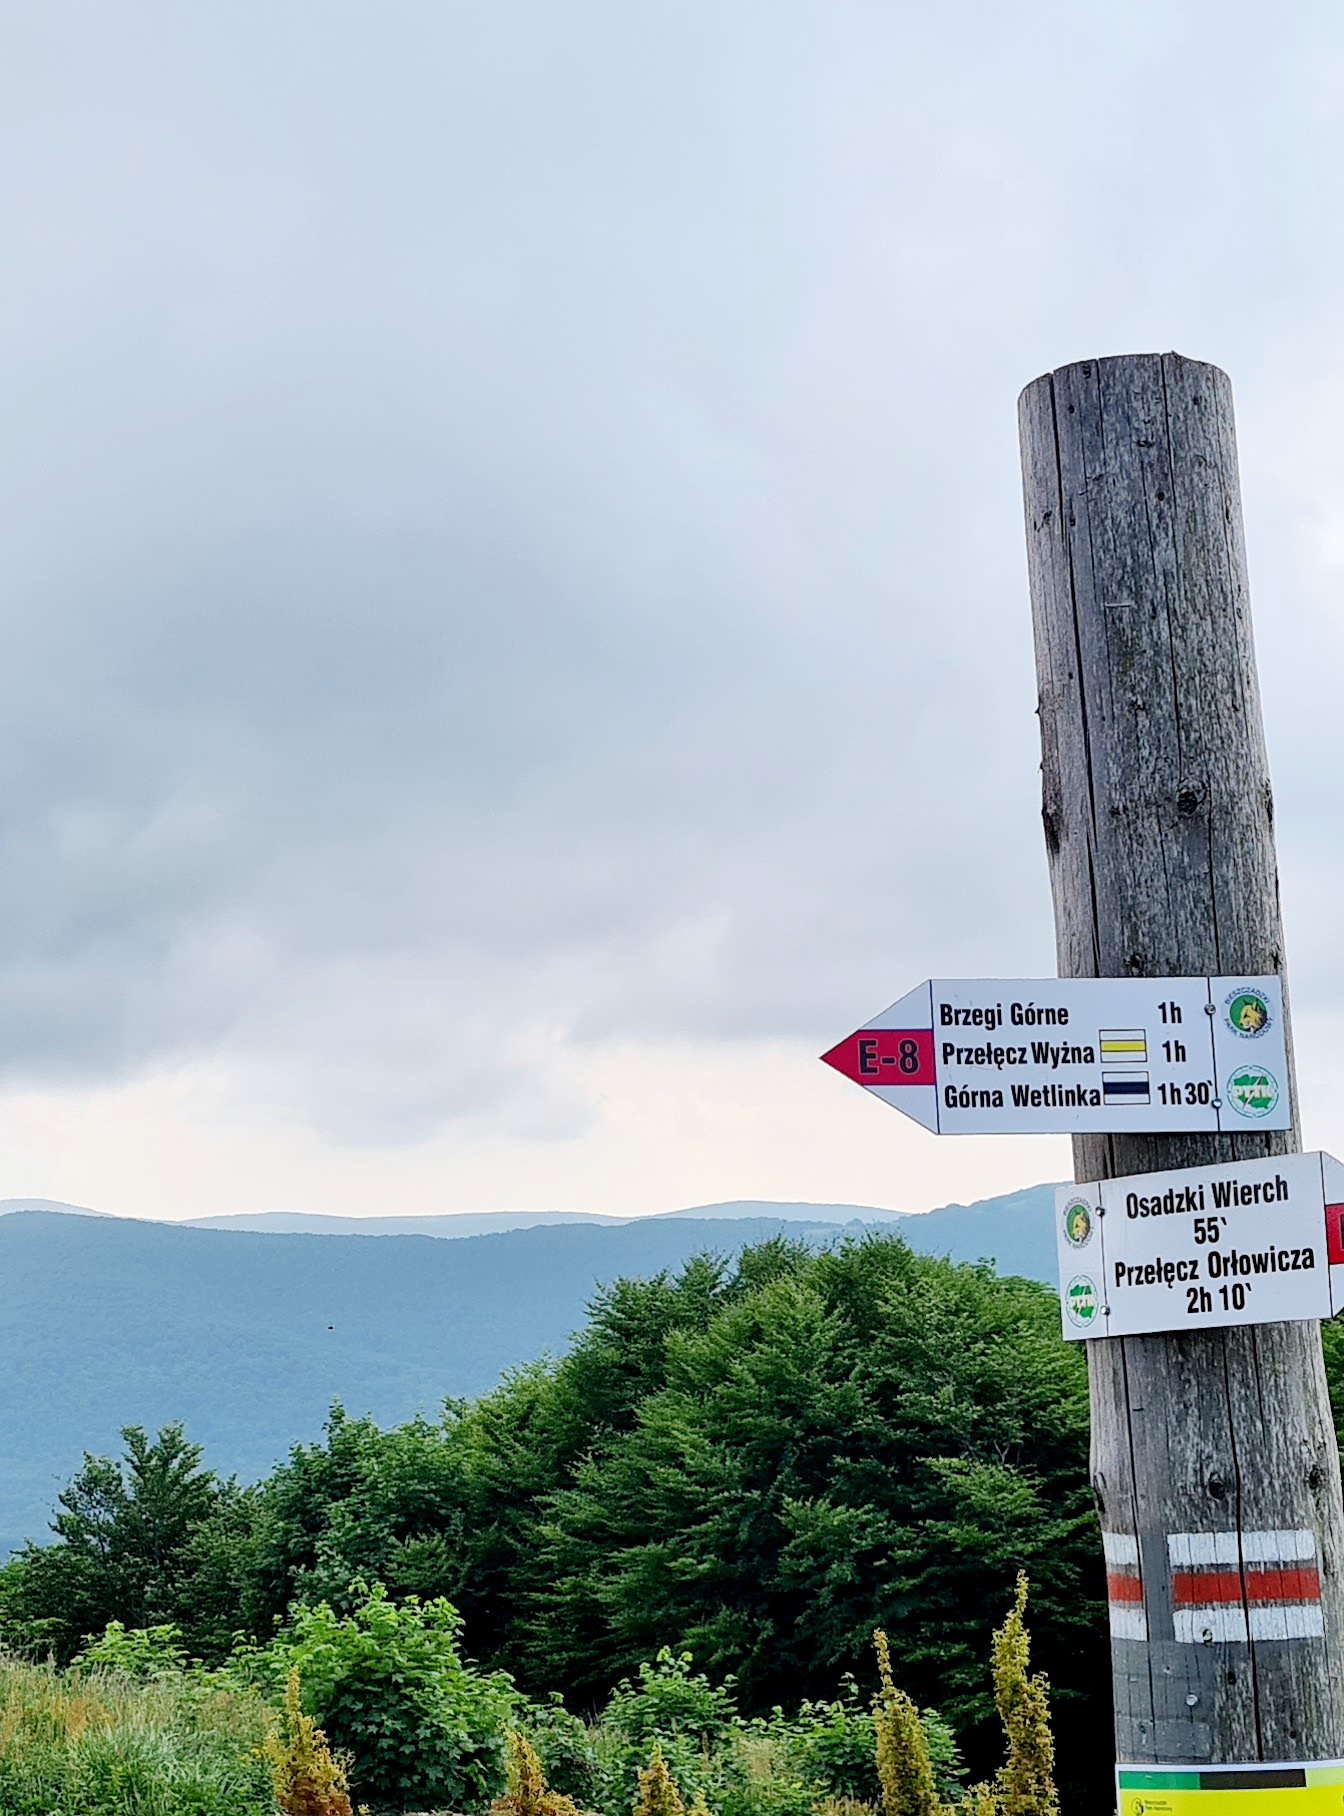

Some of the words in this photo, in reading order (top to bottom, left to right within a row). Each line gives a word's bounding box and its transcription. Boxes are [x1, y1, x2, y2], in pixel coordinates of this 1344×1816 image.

[939, 1003, 1003, 1031] Brzegi
[1010, 1001, 1069, 1026] Górne
[1157, 1001, 1182, 1024] 1h
[858, 1038, 921, 1074] E-8
[942, 1042, 1028, 1071] Przełęcz
[1030, 1041, 1095, 1070] Wyżna
[1162, 1039, 1187, 1063] 1h
[944, 1083, 1004, 1109] Górna
[1010, 1083, 1101, 1108] Wetlinka
[1126, 1186, 1205, 1219] Osadzki
[1211, 1174, 1289, 1209] Wierch
[1114, 1259, 1200, 1290] Przełęcz
[1207, 1245, 1315, 1279] Orłowicza
[1186, 1286, 1213, 1314] 2h
